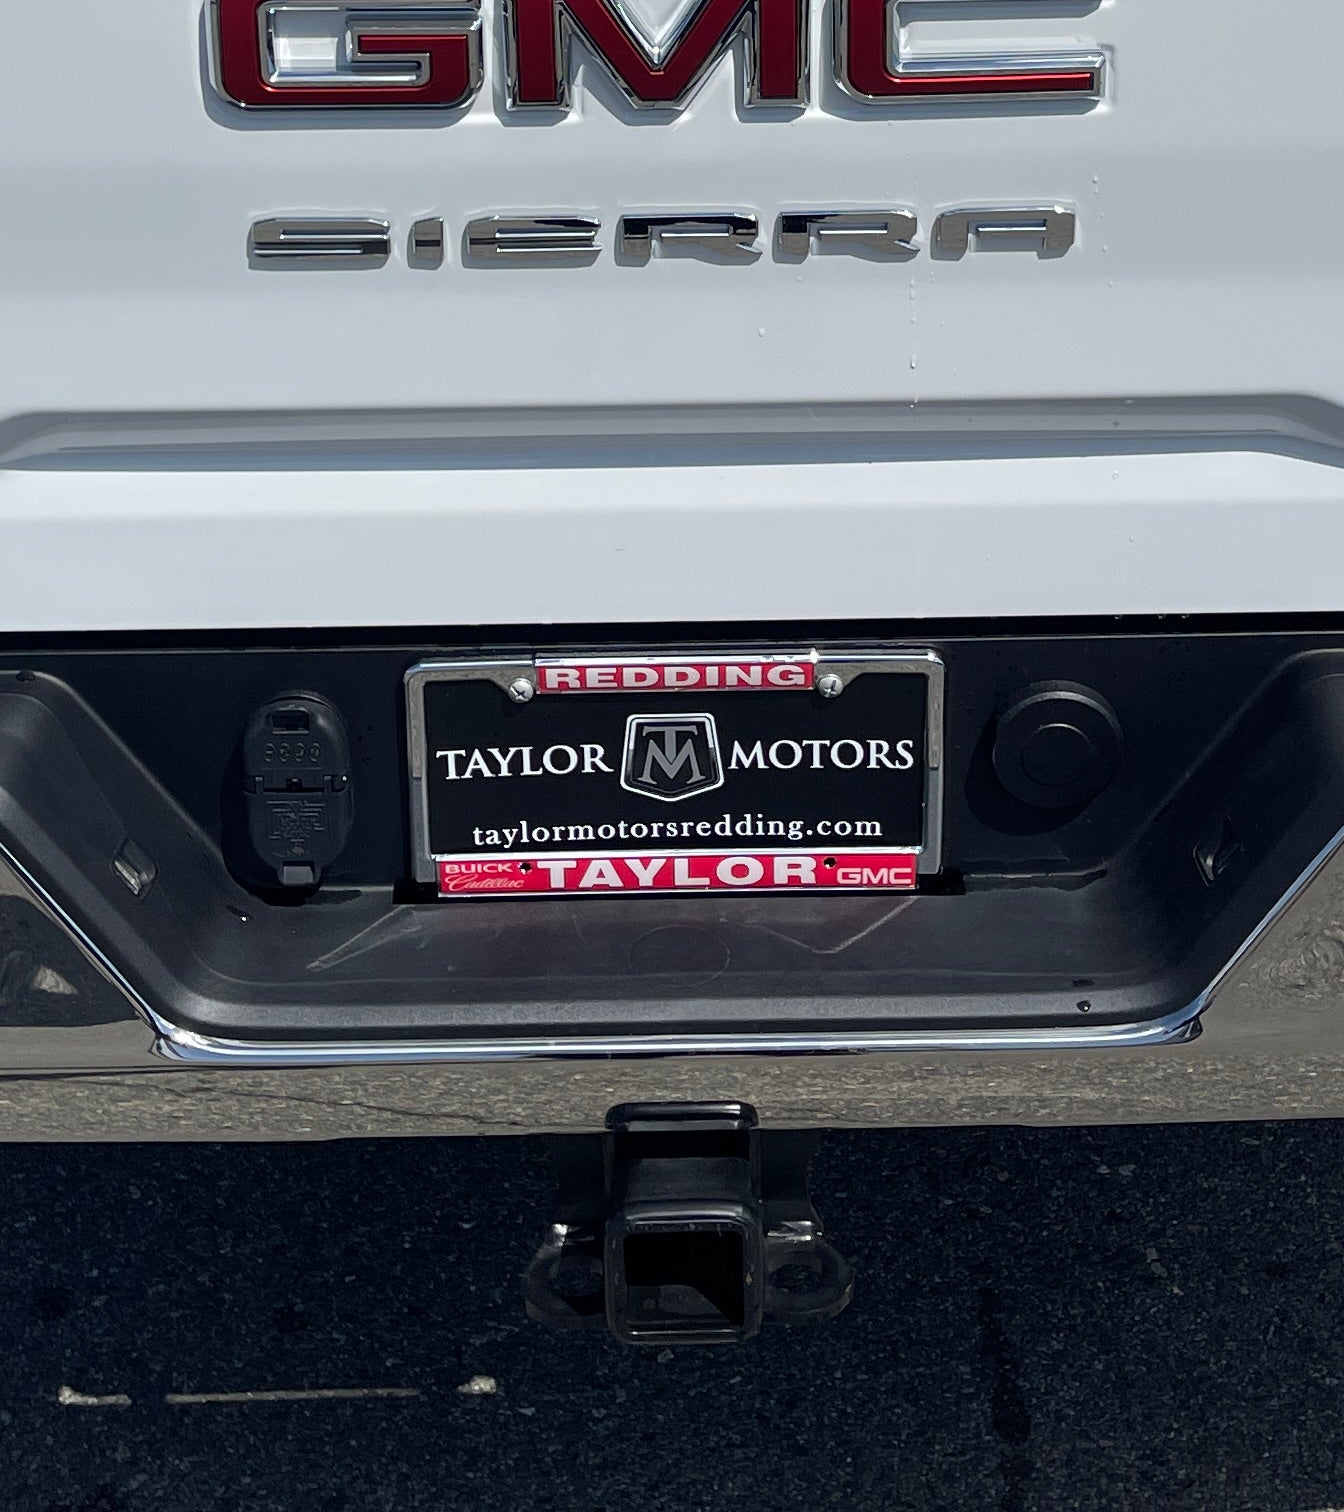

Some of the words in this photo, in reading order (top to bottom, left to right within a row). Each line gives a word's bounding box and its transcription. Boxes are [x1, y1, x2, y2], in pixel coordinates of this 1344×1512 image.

[247, 206, 1078, 271] SIERRA
[545, 665, 806, 690] REDDING
[435, 743, 615, 781] TAYLOR
[726, 739, 914, 771] MOTORS
[472, 812, 883, 848] taylormotorsredding.com
[444, 862, 513, 874] BUICK
[536, 855, 817, 890] TAYLOR
[836, 868, 912, 885] GMC
[444, 873, 525, 892] Cadillac
